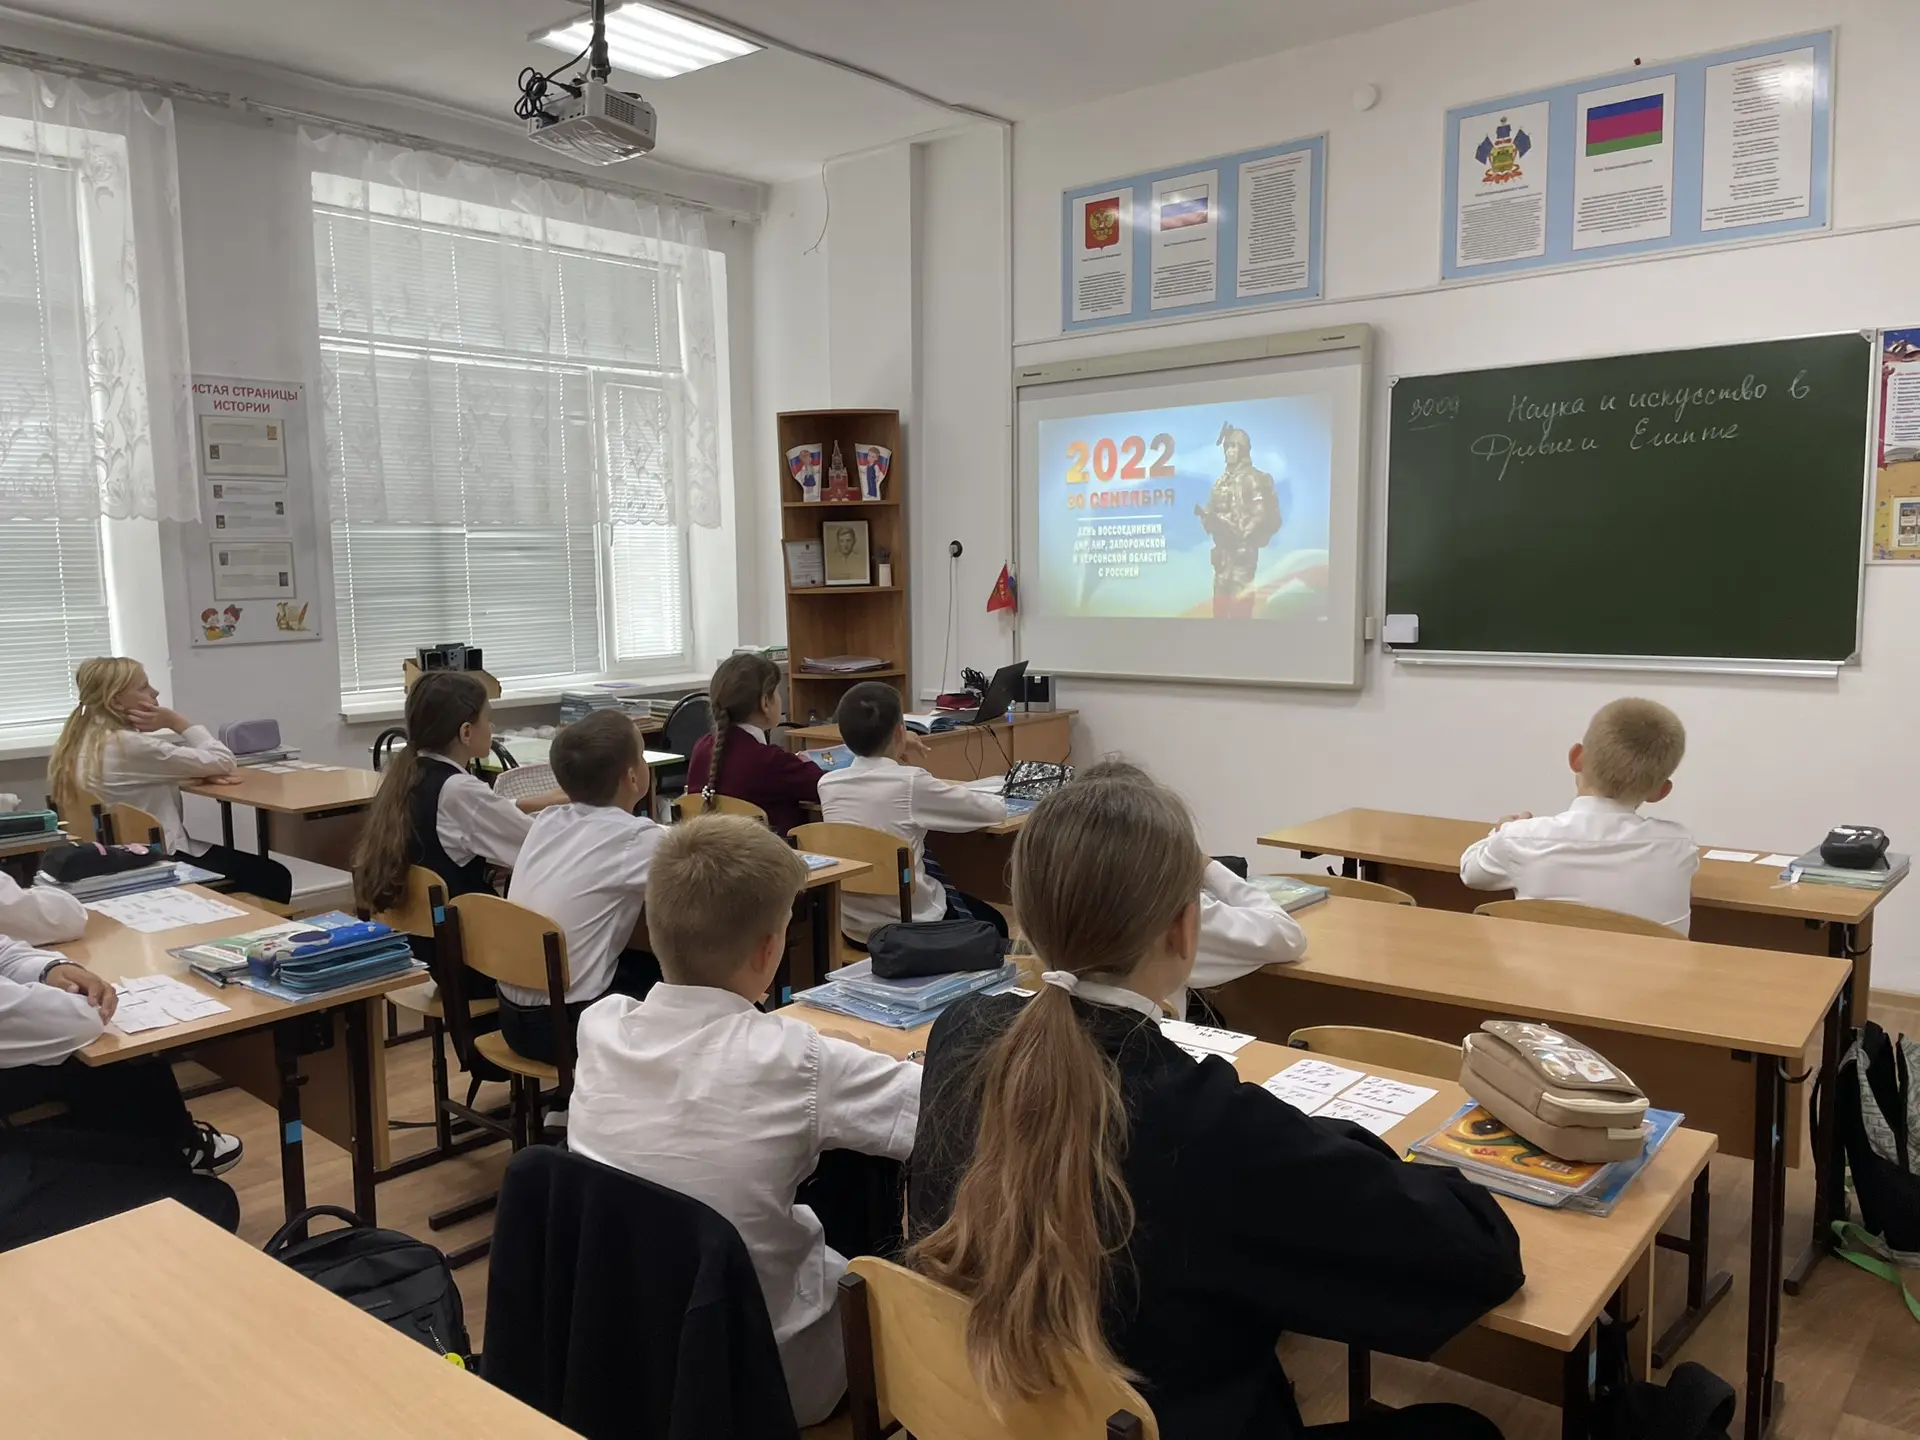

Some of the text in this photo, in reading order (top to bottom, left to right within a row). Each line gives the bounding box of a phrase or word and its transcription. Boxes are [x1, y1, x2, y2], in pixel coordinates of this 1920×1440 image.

[191, 383, 298, 402] ИСТАЯ СТРАНИЦЫ
[213, 400, 271, 413] ИСТОРИИ
[1508, 394, 1585, 432] Наука
[1600, 395, 1616, 411] и
[1629, 374, 1767, 422] искусство
[1629, 417, 1740, 450] Египте
[1065, 432, 1175, 484] 2022
[1090, 488, 1175, 509] СЕНТЯБРЯ
[1077, 524, 1162, 537] ДЕНЬ ВОССОЕДИНЕНИЯ
[1109, 535, 1166, 550] ЗАПОРОЖСКОЙ
[1081, 551, 1127, 564] ХЕРСОНСКОЙ
[1129, 550, 1167, 563] ОБЛАСТЕЙ
[1098, 565, 1140, 578] С РОССИЕЙ
